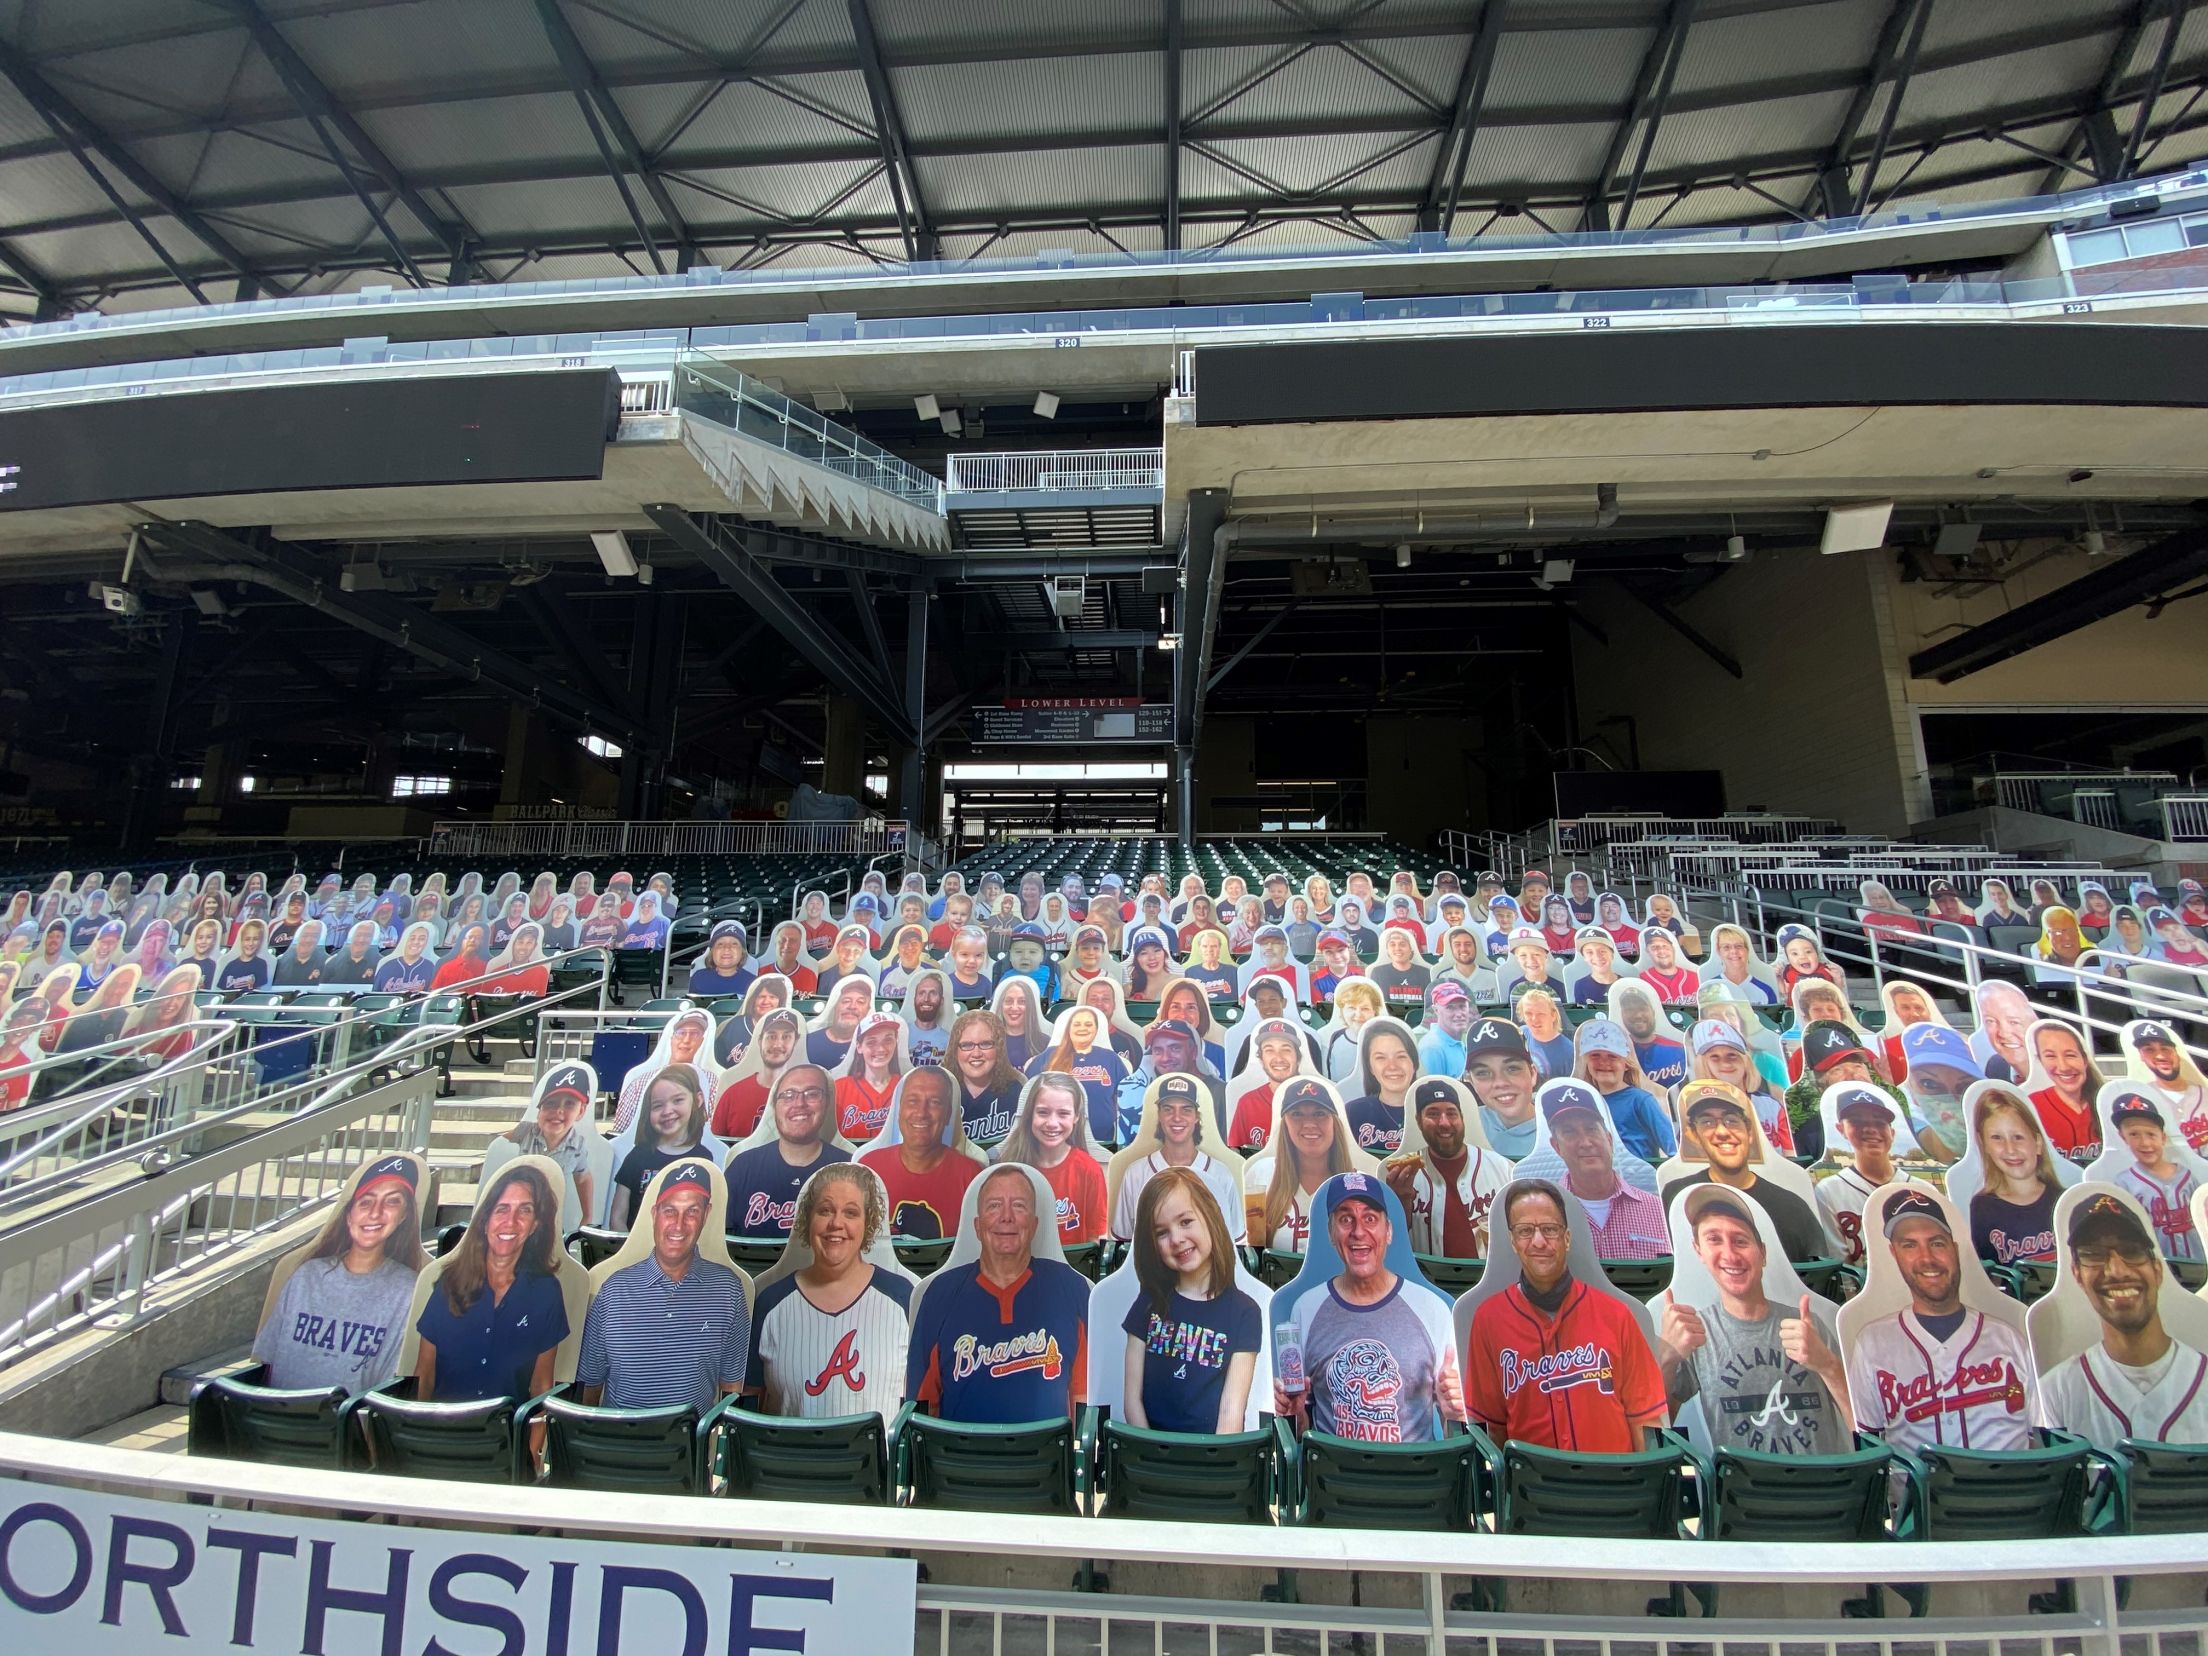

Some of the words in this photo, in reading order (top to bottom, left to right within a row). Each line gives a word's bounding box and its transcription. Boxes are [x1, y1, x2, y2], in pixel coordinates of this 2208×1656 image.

[2067, 303, 2089, 313] 323
[1587, 318, 1607, 327] 322
[1058, 339, 1077, 348] 320
[565, 359, 582, 368] 318
[1021, 699, 1071, 708] LOWER
[1080, 698, 1125, 707] LEVEL
[511, 805, 576, 818] BALLPARK
[1473, 1020, 1498, 1042] A
[1824, 1030, 1844, 1047] A
[1912, 1028, 1946, 1046] A
[556, 1070, 576, 1087] A
[1647, 1060, 1682, 1081] aves
[1558, 1088, 1578, 1102] A
[842, 1104, 890, 1130] Brav
[378, 1158, 402, 1172] A
[676, 1166, 696, 1180] A
[744, 1191, 796, 1229] Bra
[1989, 1229, 2056, 1264] Brav
[516, 1314, 528, 1327] A
[293, 1312, 387, 1357] BRAVES
[1146, 1312, 1228, 1368] BRAVES
[805, 1328, 866, 1396] A
[953, 1328, 1046, 1382] Braves
[1500, 1342, 1594, 1400] Braves
[1720, 1347, 1808, 1390] ATLANTA
[1876, 1357, 2004, 1424] Braves
[1750, 1380, 1798, 1426] A
[1336, 1421, 1402, 1442] BRAVOS
[1734, 1416, 1818, 1454] BRAVES
